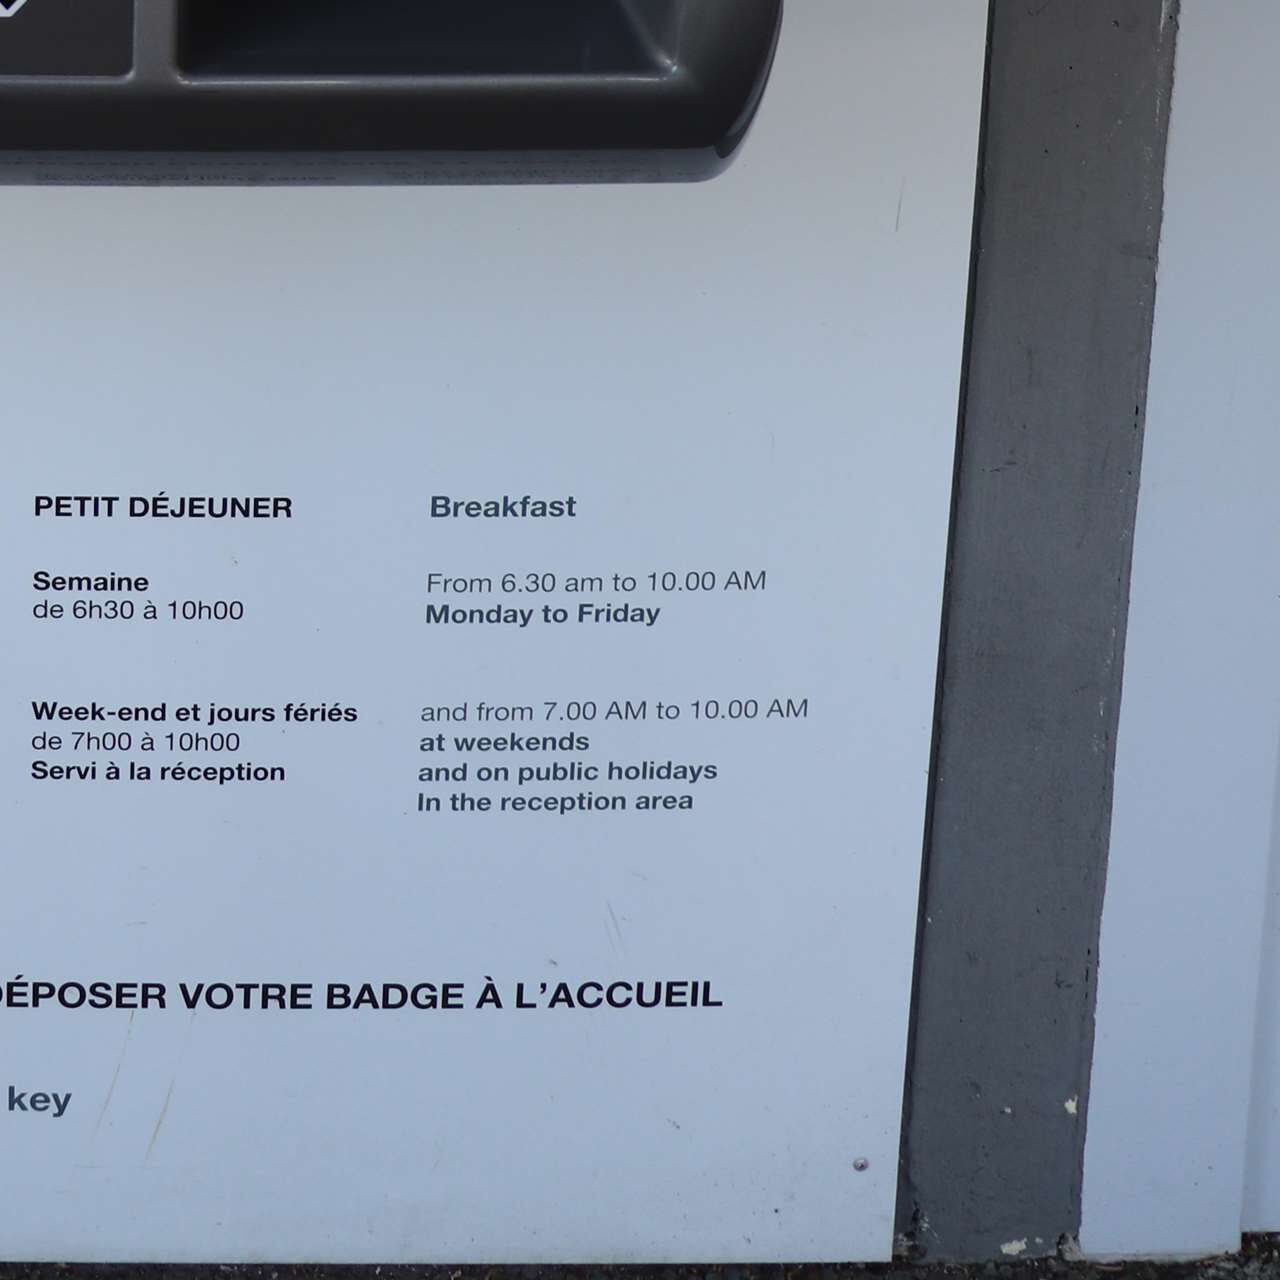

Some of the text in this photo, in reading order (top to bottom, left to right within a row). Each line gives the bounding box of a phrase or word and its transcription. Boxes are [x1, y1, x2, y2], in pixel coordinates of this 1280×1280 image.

[35, 492, 291, 518] PETIT DÉJEUNER
[431, 496, 576, 517] Breakfast
[33, 571, 148, 591] Semaine
[33, 600, 243, 620] de 6h30 à 10h00
[426, 603, 660, 627] Monday to Friday
[32, 702, 357, 725] Week-end et jours fériés
[420, 732, 589, 752] at weekends
[32, 761, 284, 785] Servi à la réception
[179, 983, 312, 1009] VOTRE
[327, 983, 464, 1009] BADGE
[476, 976, 502, 1008] À
[516, 981, 722, 1008] L'ACCUEIL
